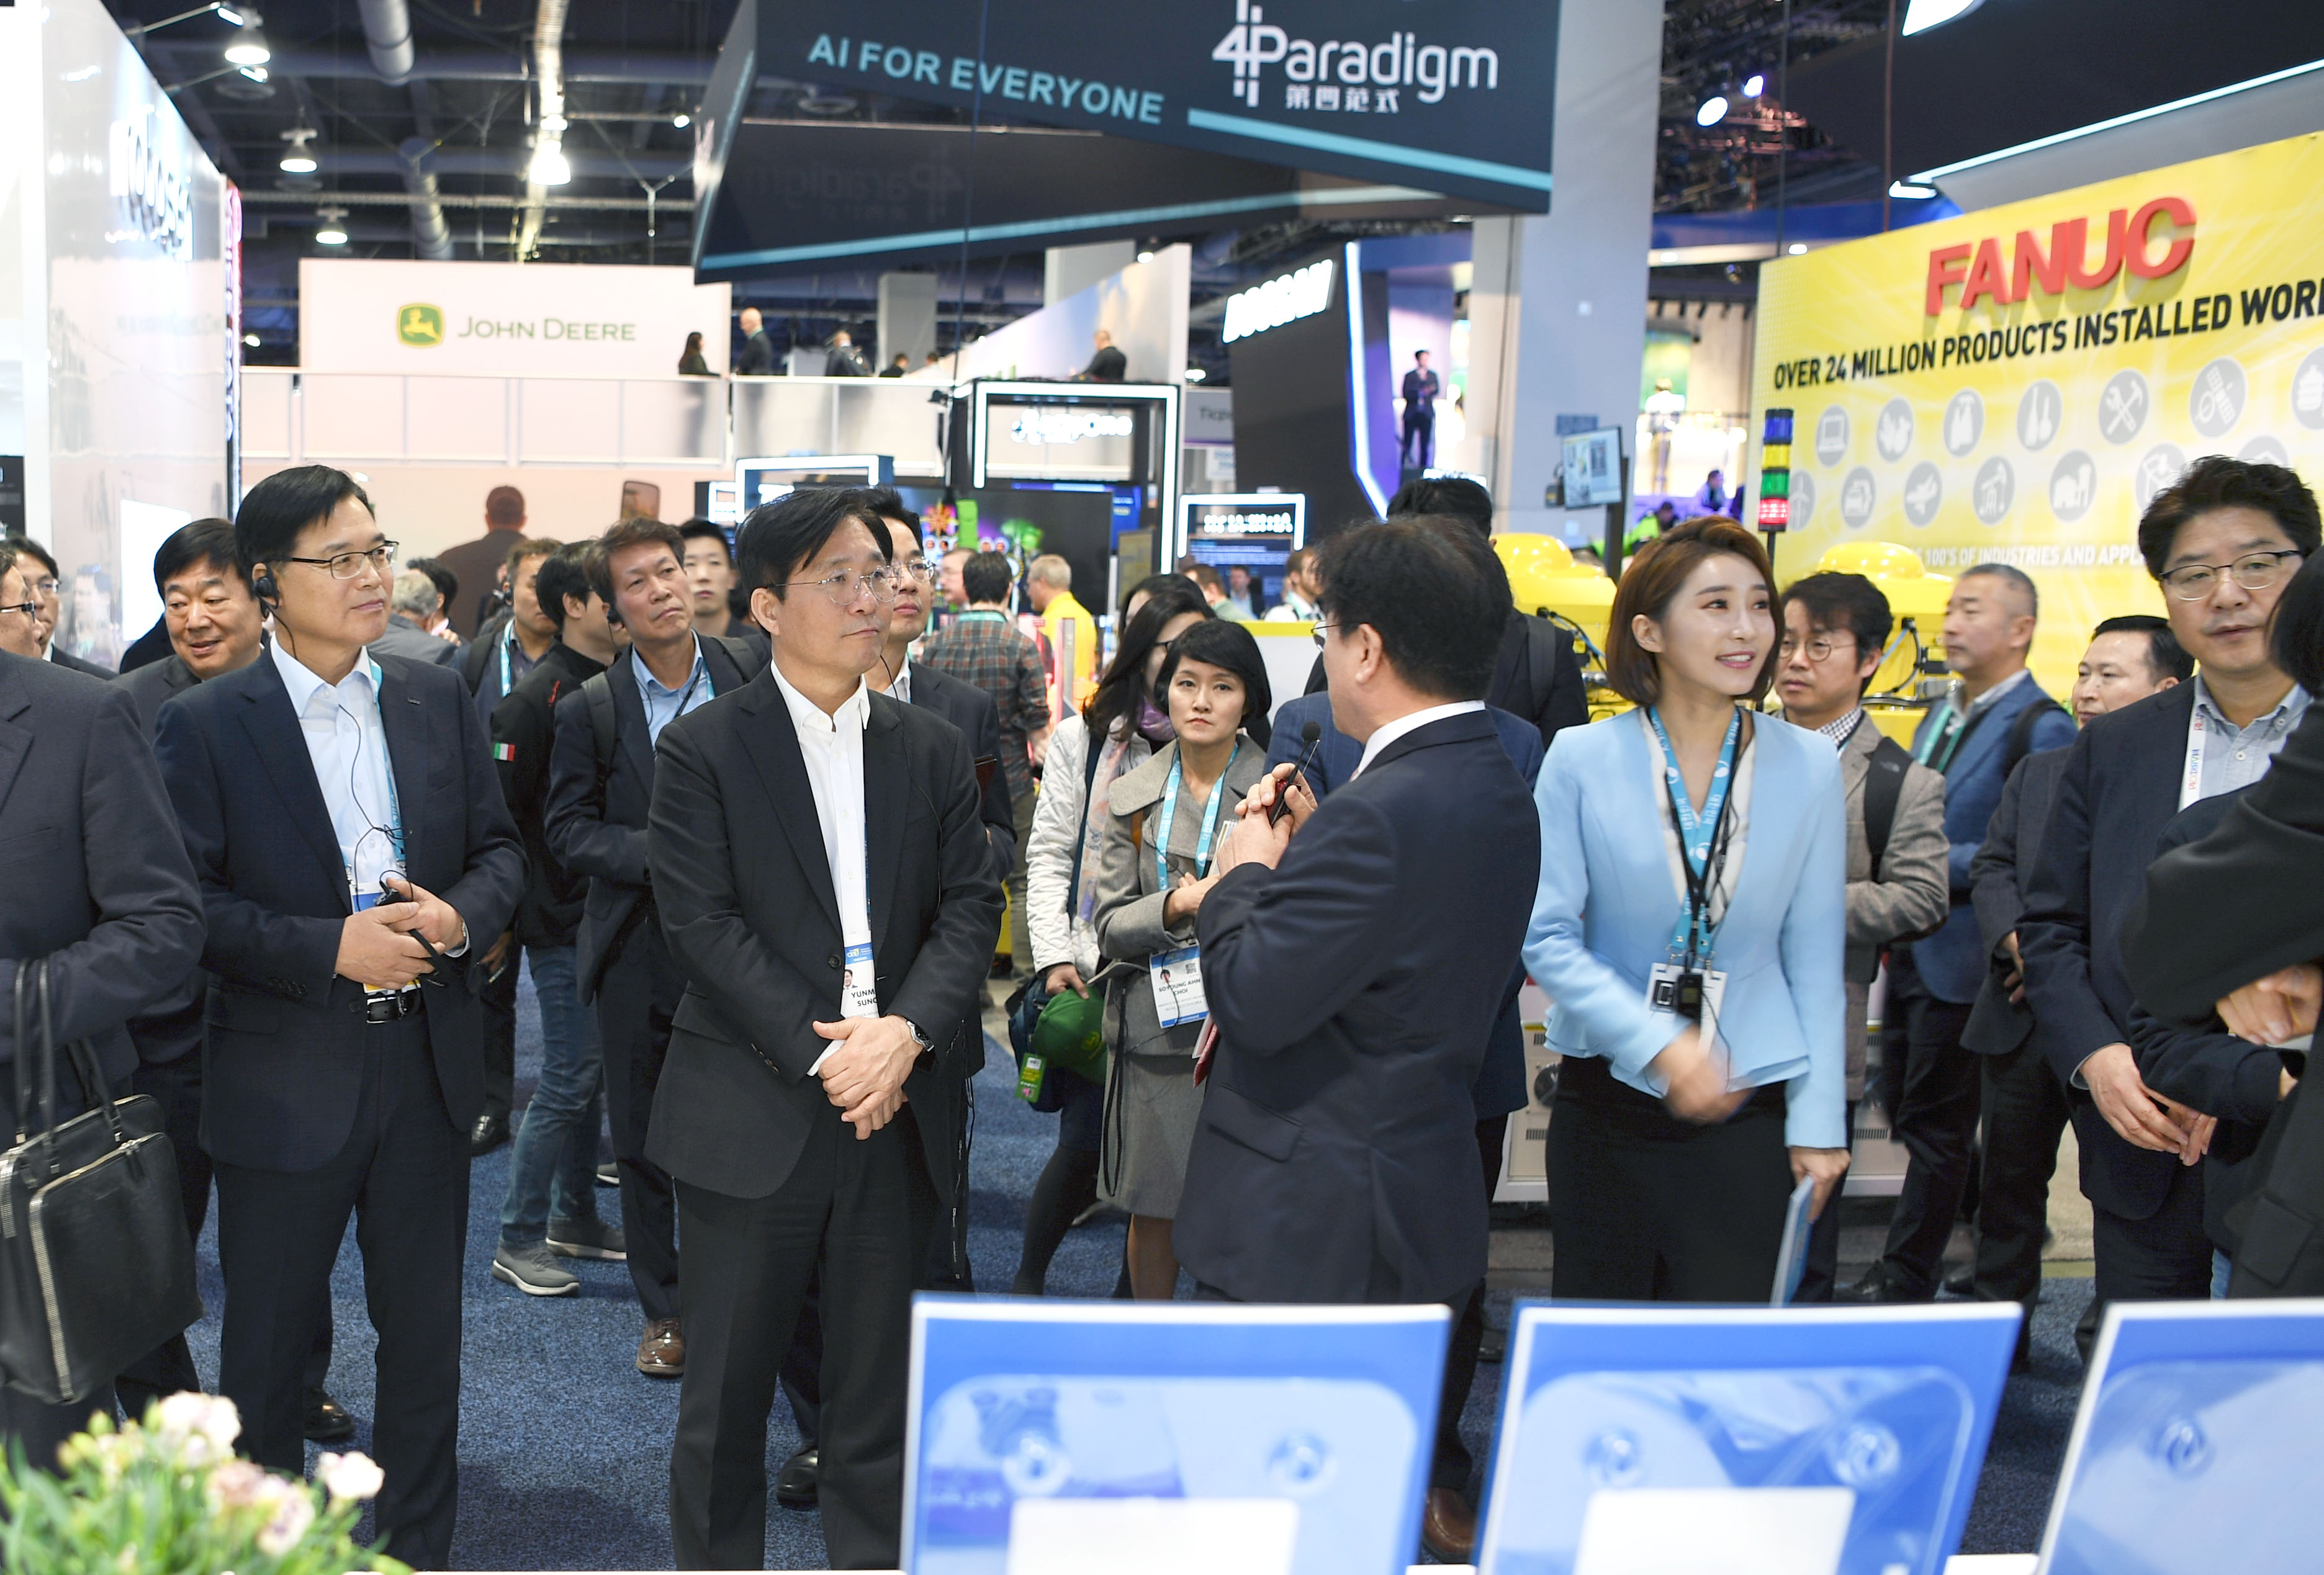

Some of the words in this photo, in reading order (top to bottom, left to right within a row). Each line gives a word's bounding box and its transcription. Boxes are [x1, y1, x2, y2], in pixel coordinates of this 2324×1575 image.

[808, 33, 851, 68] AI
[859, 40, 941, 86] FOR
[950, 56, 1164, 125] EVERYONE
[1286, 84, 1400, 114] 第四范式
[1925, 196, 2197, 317] FANUC
[458, 316, 535, 339] JOHN
[544, 318, 637, 341] DEERE
[1774, 361, 1822, 390] OVER
[1825, 357, 1847, 385] 24
[1852, 340, 1935, 380] MILLION
[1942, 320, 2066, 364] PRODUCTS
[2074, 294, 2231, 349] INSTALLED
[1960, 546, 1977, 565] OF
[1978, 545, 2061, 566] INDUSTRIES
[2061, 545, 2096, 566] AND
